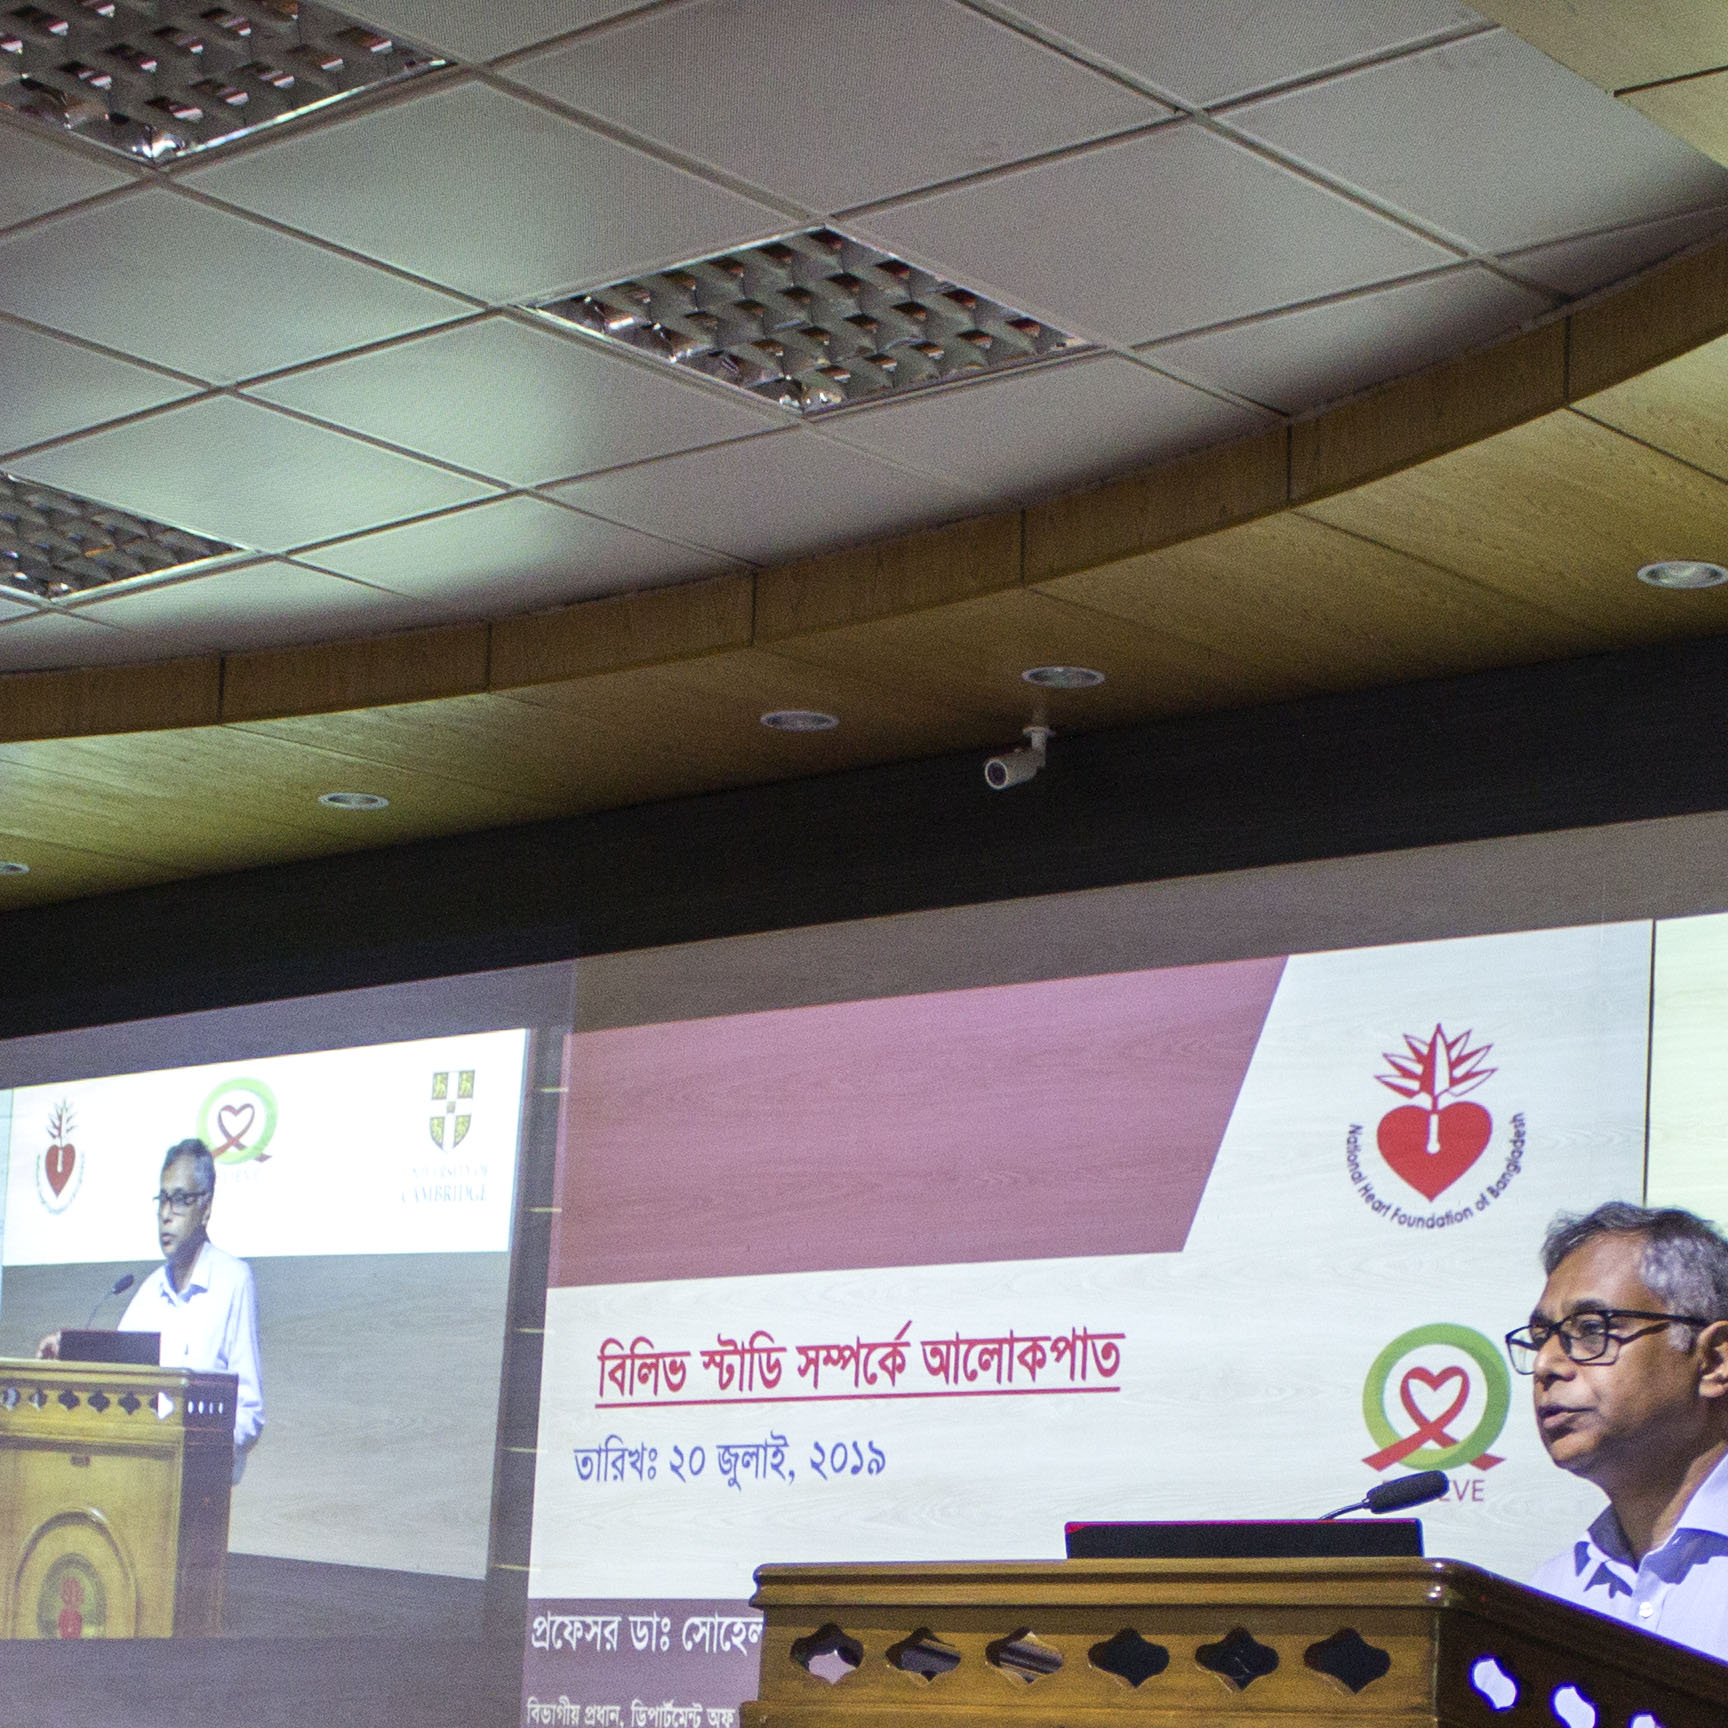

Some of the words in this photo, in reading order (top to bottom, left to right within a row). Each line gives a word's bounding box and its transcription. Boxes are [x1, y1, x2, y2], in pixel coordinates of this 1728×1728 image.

[1345, 1123, 1366, 1185] National
[1359, 1183, 1392, 1217] Heart
[1391, 1207, 1473, 1229] Foundation
[1476, 1194, 1490, 1211] of
[1487, 1112, 1524, 1199] Bangladesh
[597, 1336, 691, 1397] বিলিভ
[700, 1331, 787, 1392] স্টাডি
[796, 1320, 912, 1389] সম্পর্কে
[921, 1327, 1125, 1384] আলোকপাত
[670, 1445, 705, 1482] ২০
[811, 1441, 885, 1480] ২০১৯
[531, 1611, 622, 1651] প্রফেসর
